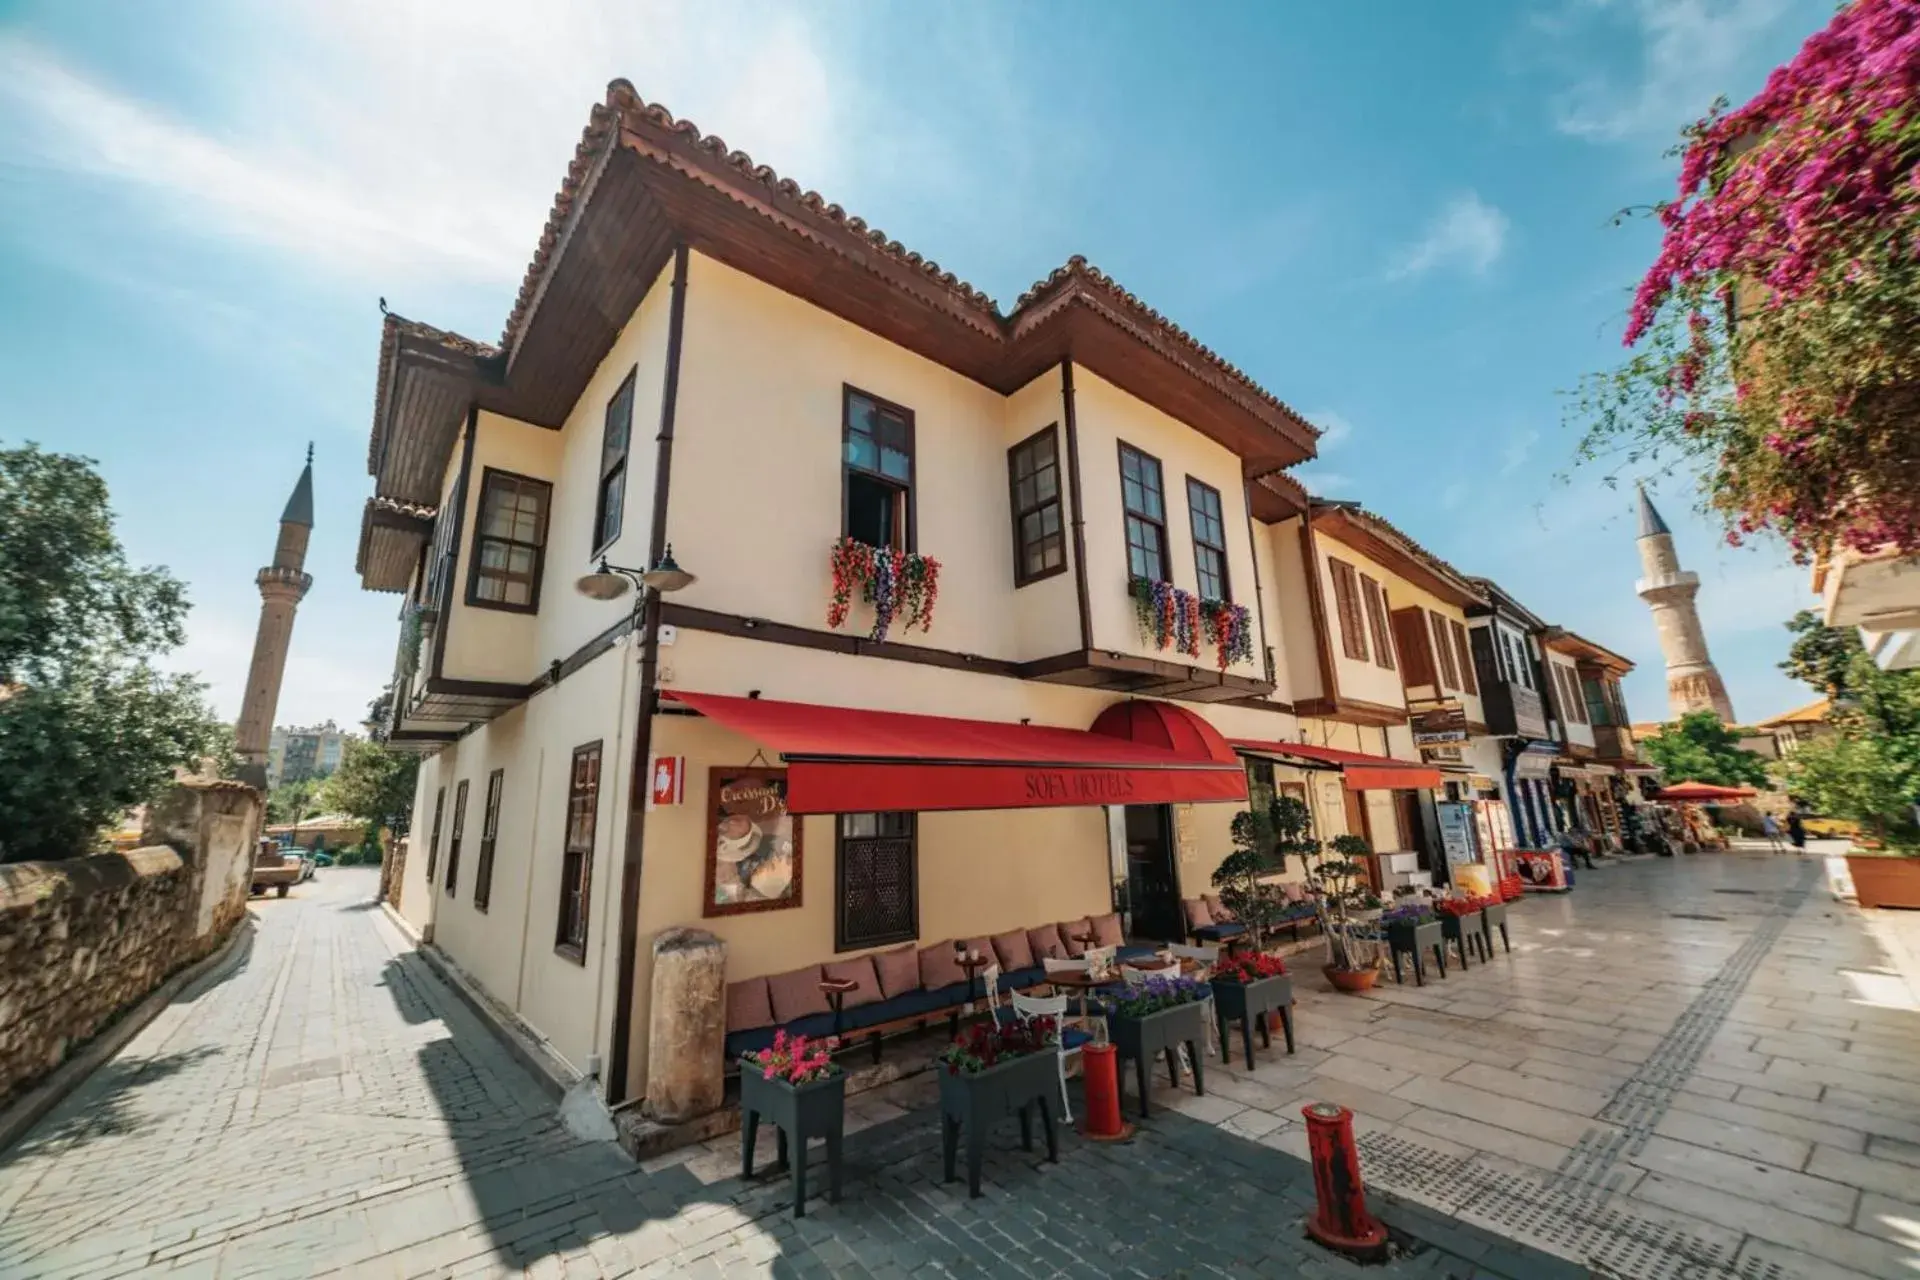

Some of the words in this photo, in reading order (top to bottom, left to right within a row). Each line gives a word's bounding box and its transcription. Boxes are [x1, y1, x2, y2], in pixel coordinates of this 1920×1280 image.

[721, 782, 780, 803] Croissant
[1025, 772, 1068, 799] SOFA
[1073, 771, 1134, 799] HOTELS
